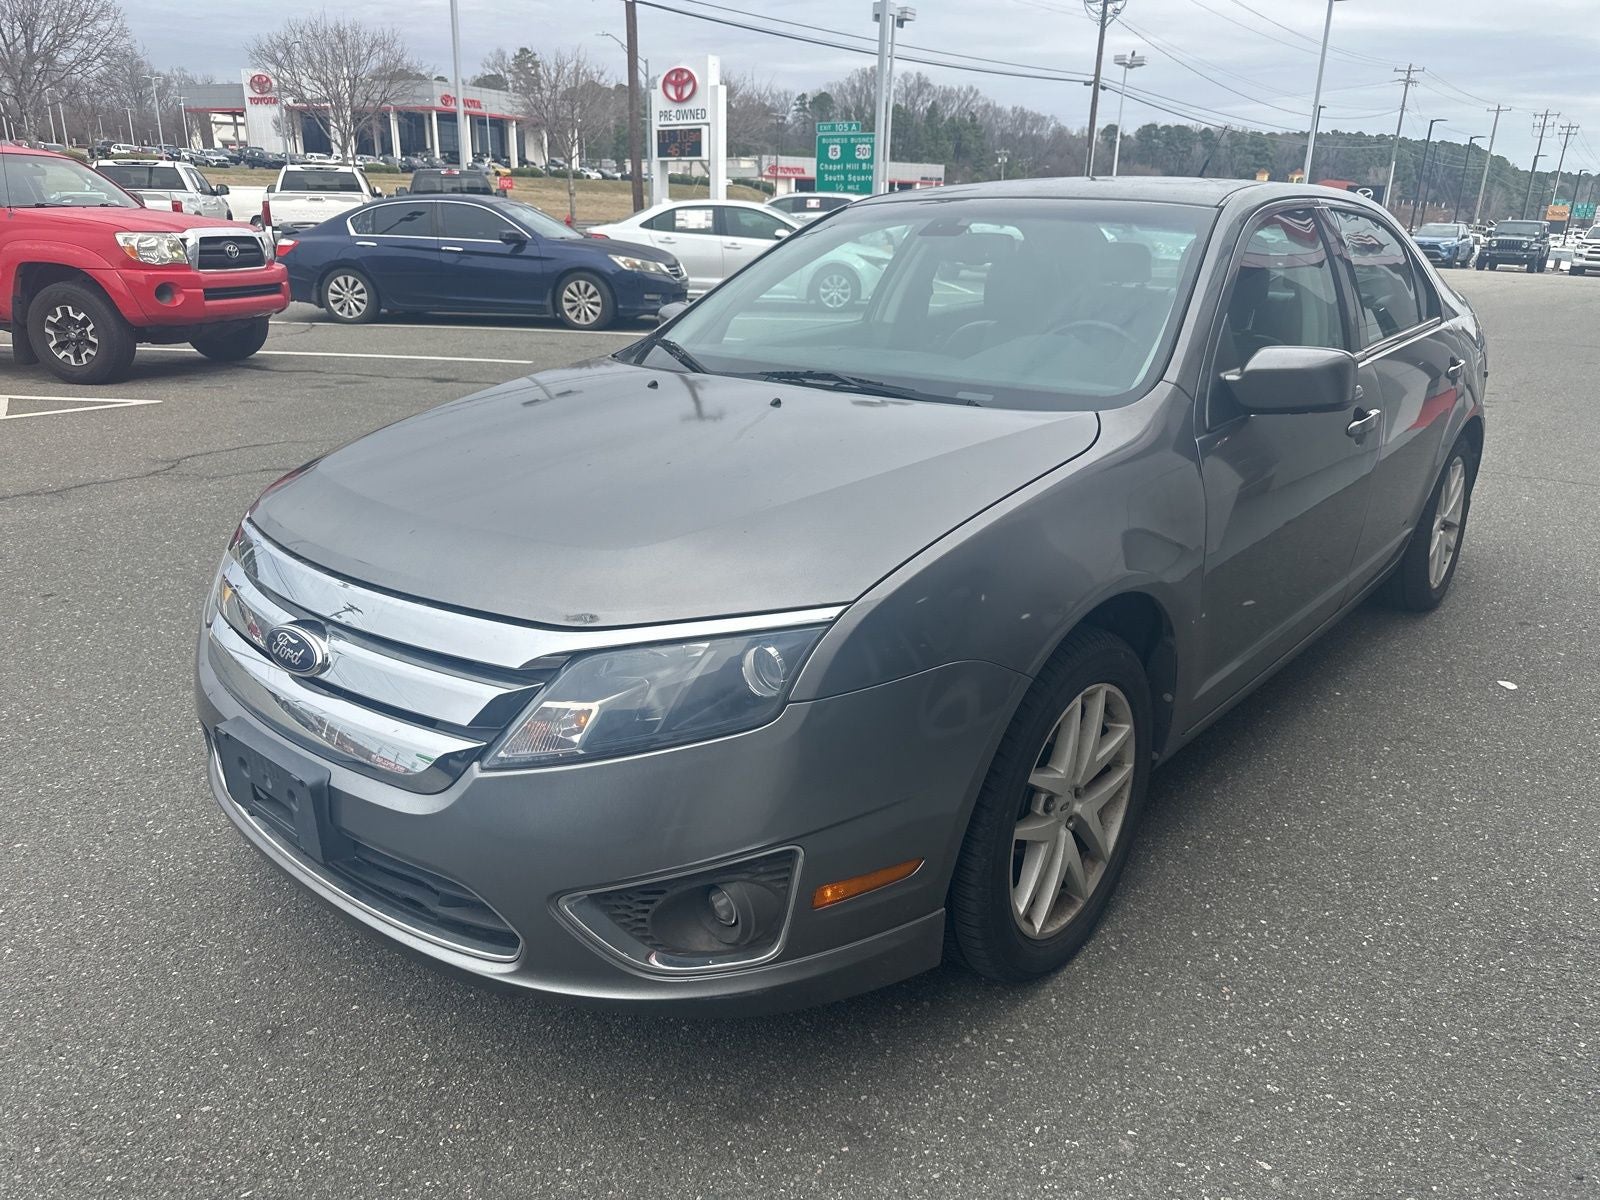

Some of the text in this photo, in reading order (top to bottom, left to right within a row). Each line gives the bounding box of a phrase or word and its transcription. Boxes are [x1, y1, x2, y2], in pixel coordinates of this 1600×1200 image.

[452, 96, 481, 109] TYOTA
[659, 108, 706, 121] PRE-OWNED
[831, 148, 838, 156] 15
[856, 148, 870, 156] 501
[778, 166, 805, 174] TOYOTA
[820, 162, 844, 172] Chapel
[862, 162, 874, 170] Blv
[824, 173, 872, 182] South Square
[272, 632, 305, 665] Ford
